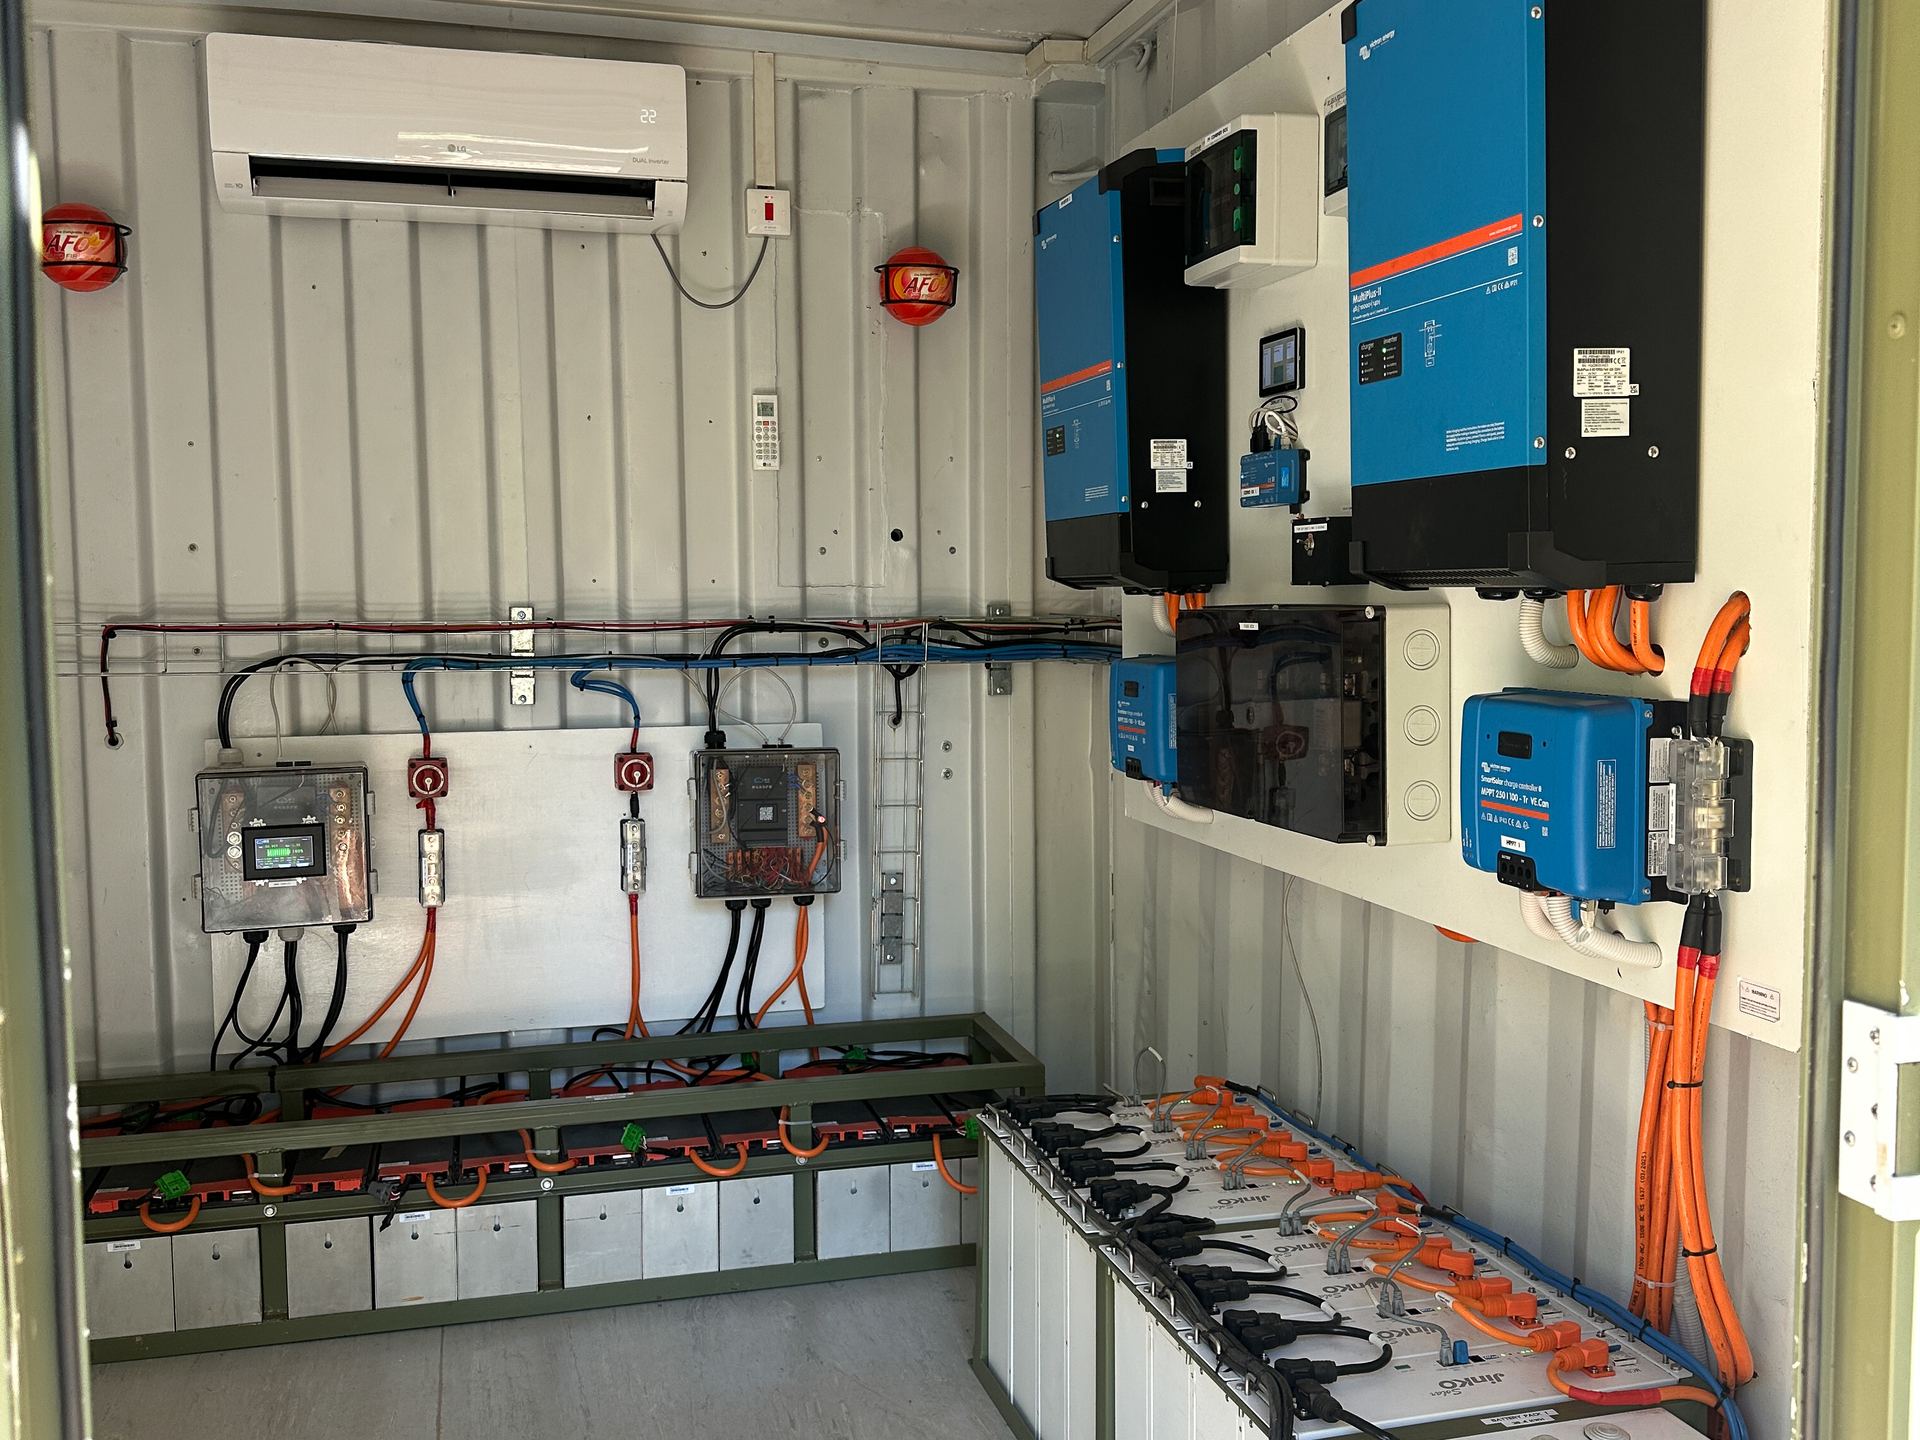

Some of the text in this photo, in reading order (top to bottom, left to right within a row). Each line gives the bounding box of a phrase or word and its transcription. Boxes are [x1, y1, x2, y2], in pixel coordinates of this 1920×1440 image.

[640, 109, 657, 124] 22
[632, 156, 648, 164] DUAL
[46, 234, 91, 253] AFO
[904, 276, 940, 293] AFO
[1352, 286, 1382, 304] MultiPlus-II
[1480, 775, 1539, 792] SmartSolar charge controller
[1480, 787, 1496, 798] MPPT
[1495, 790, 1506, 799] 250
[1509, 793, 1519, 802] 100
[1522, 795, 1529, 804] Tr
[1490, 1413, 1523, 1423] BATTERY
[1523, 1411, 1543, 1419] PACK
